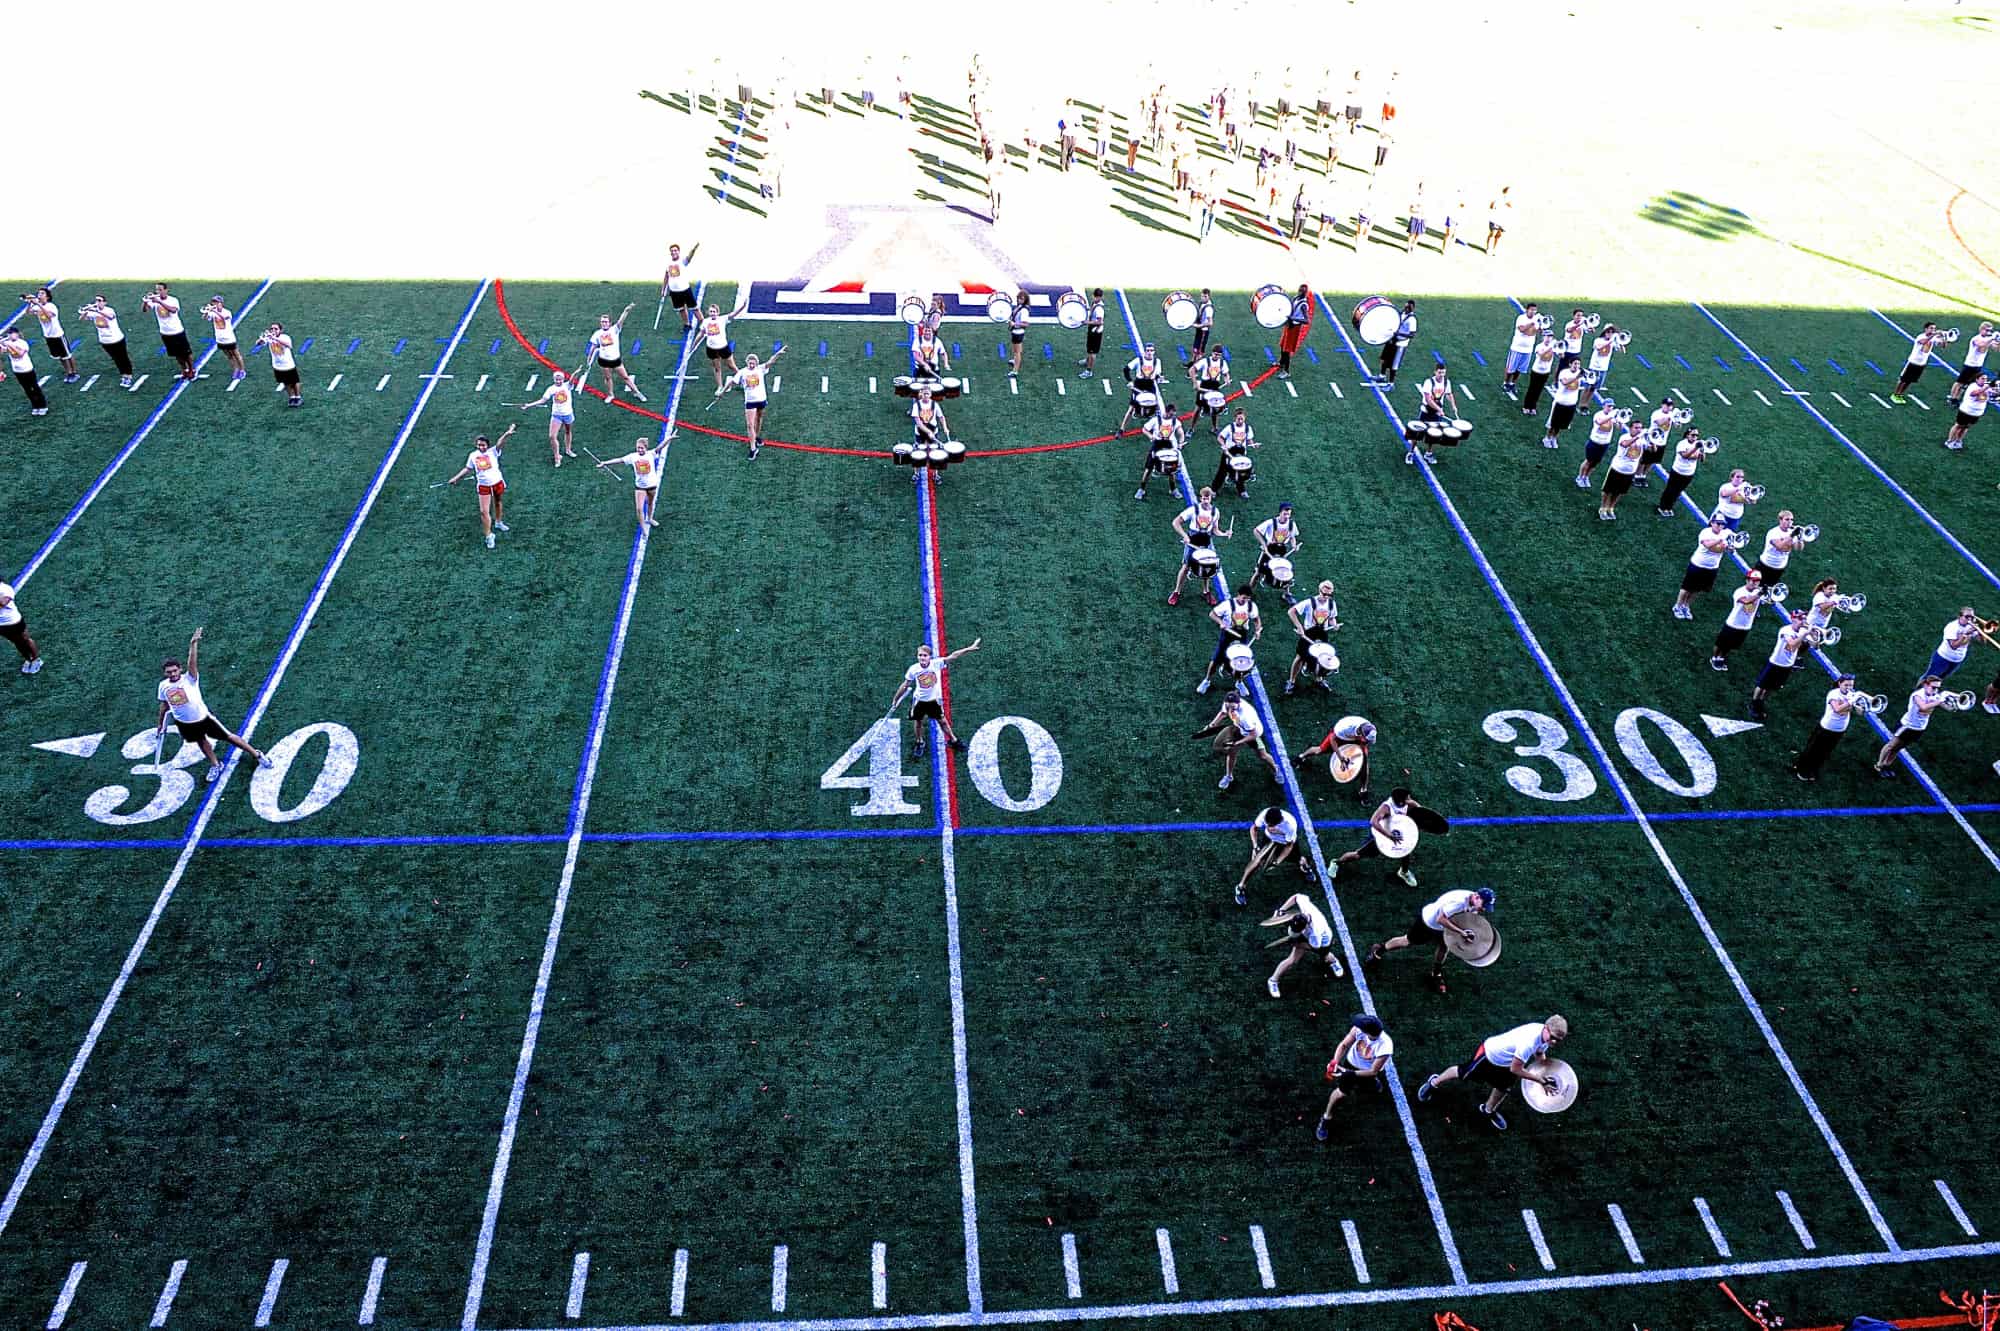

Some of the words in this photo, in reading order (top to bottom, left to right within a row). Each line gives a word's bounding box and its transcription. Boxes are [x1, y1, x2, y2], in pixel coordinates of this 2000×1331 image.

[84, 721, 360, 826] 30
[820, 715, 1064, 816] 40
[1482, 707, 1718, 801] 30
